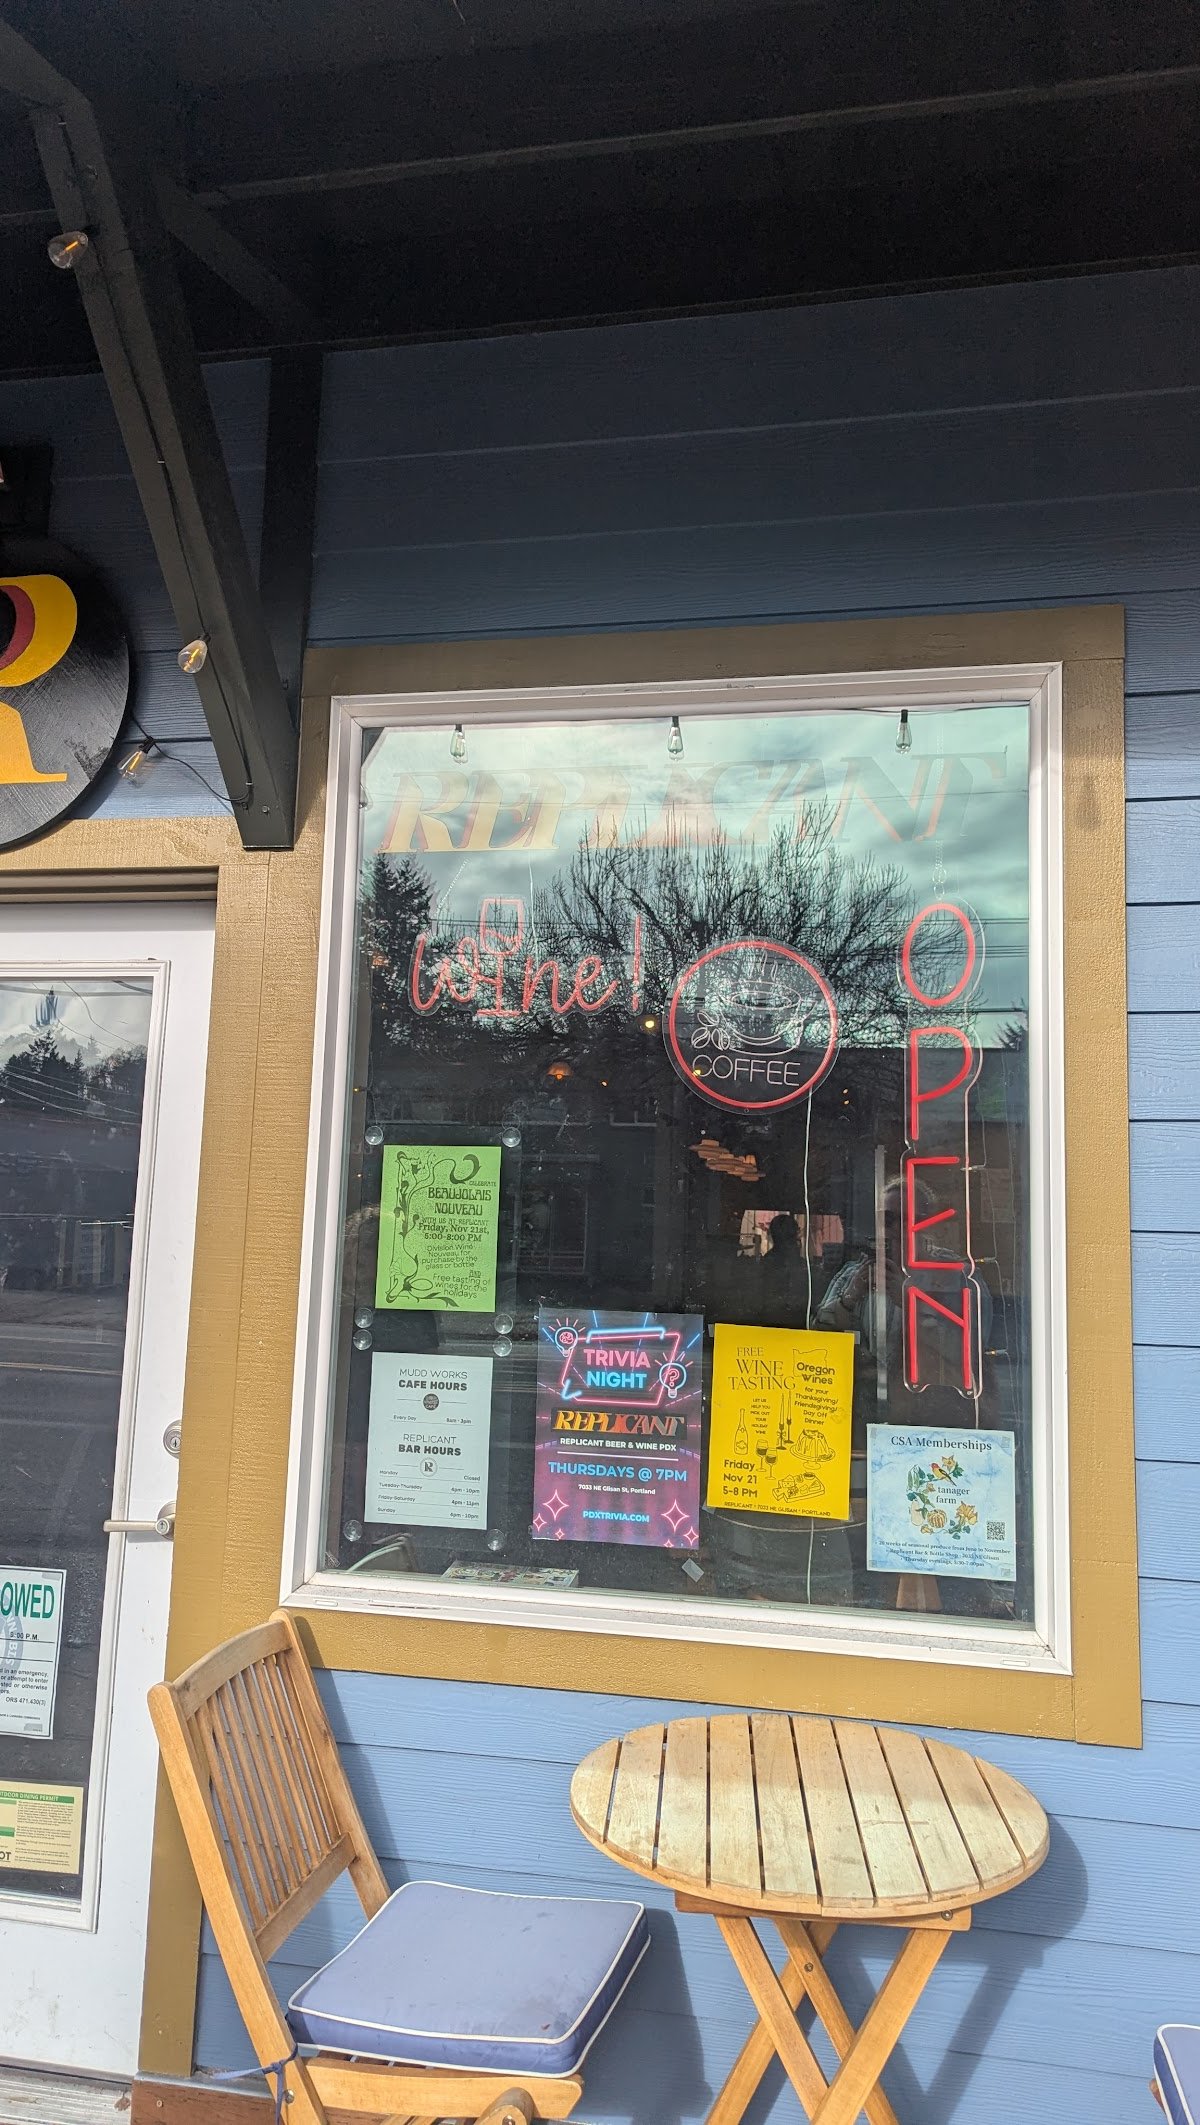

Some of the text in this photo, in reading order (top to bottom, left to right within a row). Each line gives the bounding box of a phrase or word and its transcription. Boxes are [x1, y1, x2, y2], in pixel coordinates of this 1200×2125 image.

[378, 752, 1008, 853] REPLICANT
[693, 1054, 801, 1087] COFFEE
[903, 903, 977, 1389] OPEN
[428, 1187, 492, 1200] BEAUJOLAIS
[434, 1203, 483, 1216] NOUVEAU
[459, 1218, 489, 1226] REPLICANT
[418, 1223, 448, 1233] Friday,
[470, 1227, 489, 1235] 21st,
[424, 1233, 482, 1242] 5:00-8:00 PM
[435, 1282, 459, 1290] wines
[452, 1276, 480, 1285] tasting
[443, 1289, 477, 1299] holidays
[737, 1347, 765, 1357] FREE
[583, 1349, 651, 1368] TRIVIA
[736, 1359, 784, 1377] WINE
[796, 1362, 836, 1376] Oregon
[429, 1370, 468, 1379] WORKS
[586, 1371, 647, 1389] NIGHT
[801, 1373, 833, 1385] Wines
[398, 1379, 468, 1391] CAFE HOURS
[728, 1376, 796, 1390] TASTING
[795, 1393, 839, 1404] Thanksgiving/
[794, 1401, 838, 1413] Friendsgiving/
[803, 1409, 815, 1419] Day
[553, 1410, 685, 1436] REPLICANT
[804, 1418, 825, 1426] Dinner
[403, 1433, 457, 1444] REPLICANT
[560, 1438, 677, 1451] REPLICANT BEER & WINE PDX
[891, 1436, 992, 1452] CSA Memberships
[398, 1444, 462, 1456] BAR HOURS
[548, 1461, 687, 1482] THURSDAYS @ 7PM
[724, 1460, 755, 1472] Friday
[723, 1473, 757, 1484] Nov 21
[379, 1482, 423, 1490] Tuesday-Thursday
[621, 1486, 630, 1494] St,
[630, 1487, 656, 1495] Portland
[723, 1486, 758, 1498] 5-8 PM
[937, 1487, 970, 1496] tanager
[378, 1494, 415, 1502] Friday-Saturday
[936, 1495, 957, 1504] farm
[724, 1501, 753, 1509] REPLICANT
[801, 1508, 831, 1517] PORTLAND
[582, 1510, 650, 1522] PDXTRIVIA.COM
[904, 1556, 928, 1564] Thursday
[20, 1792, 38, 1800] DINING
